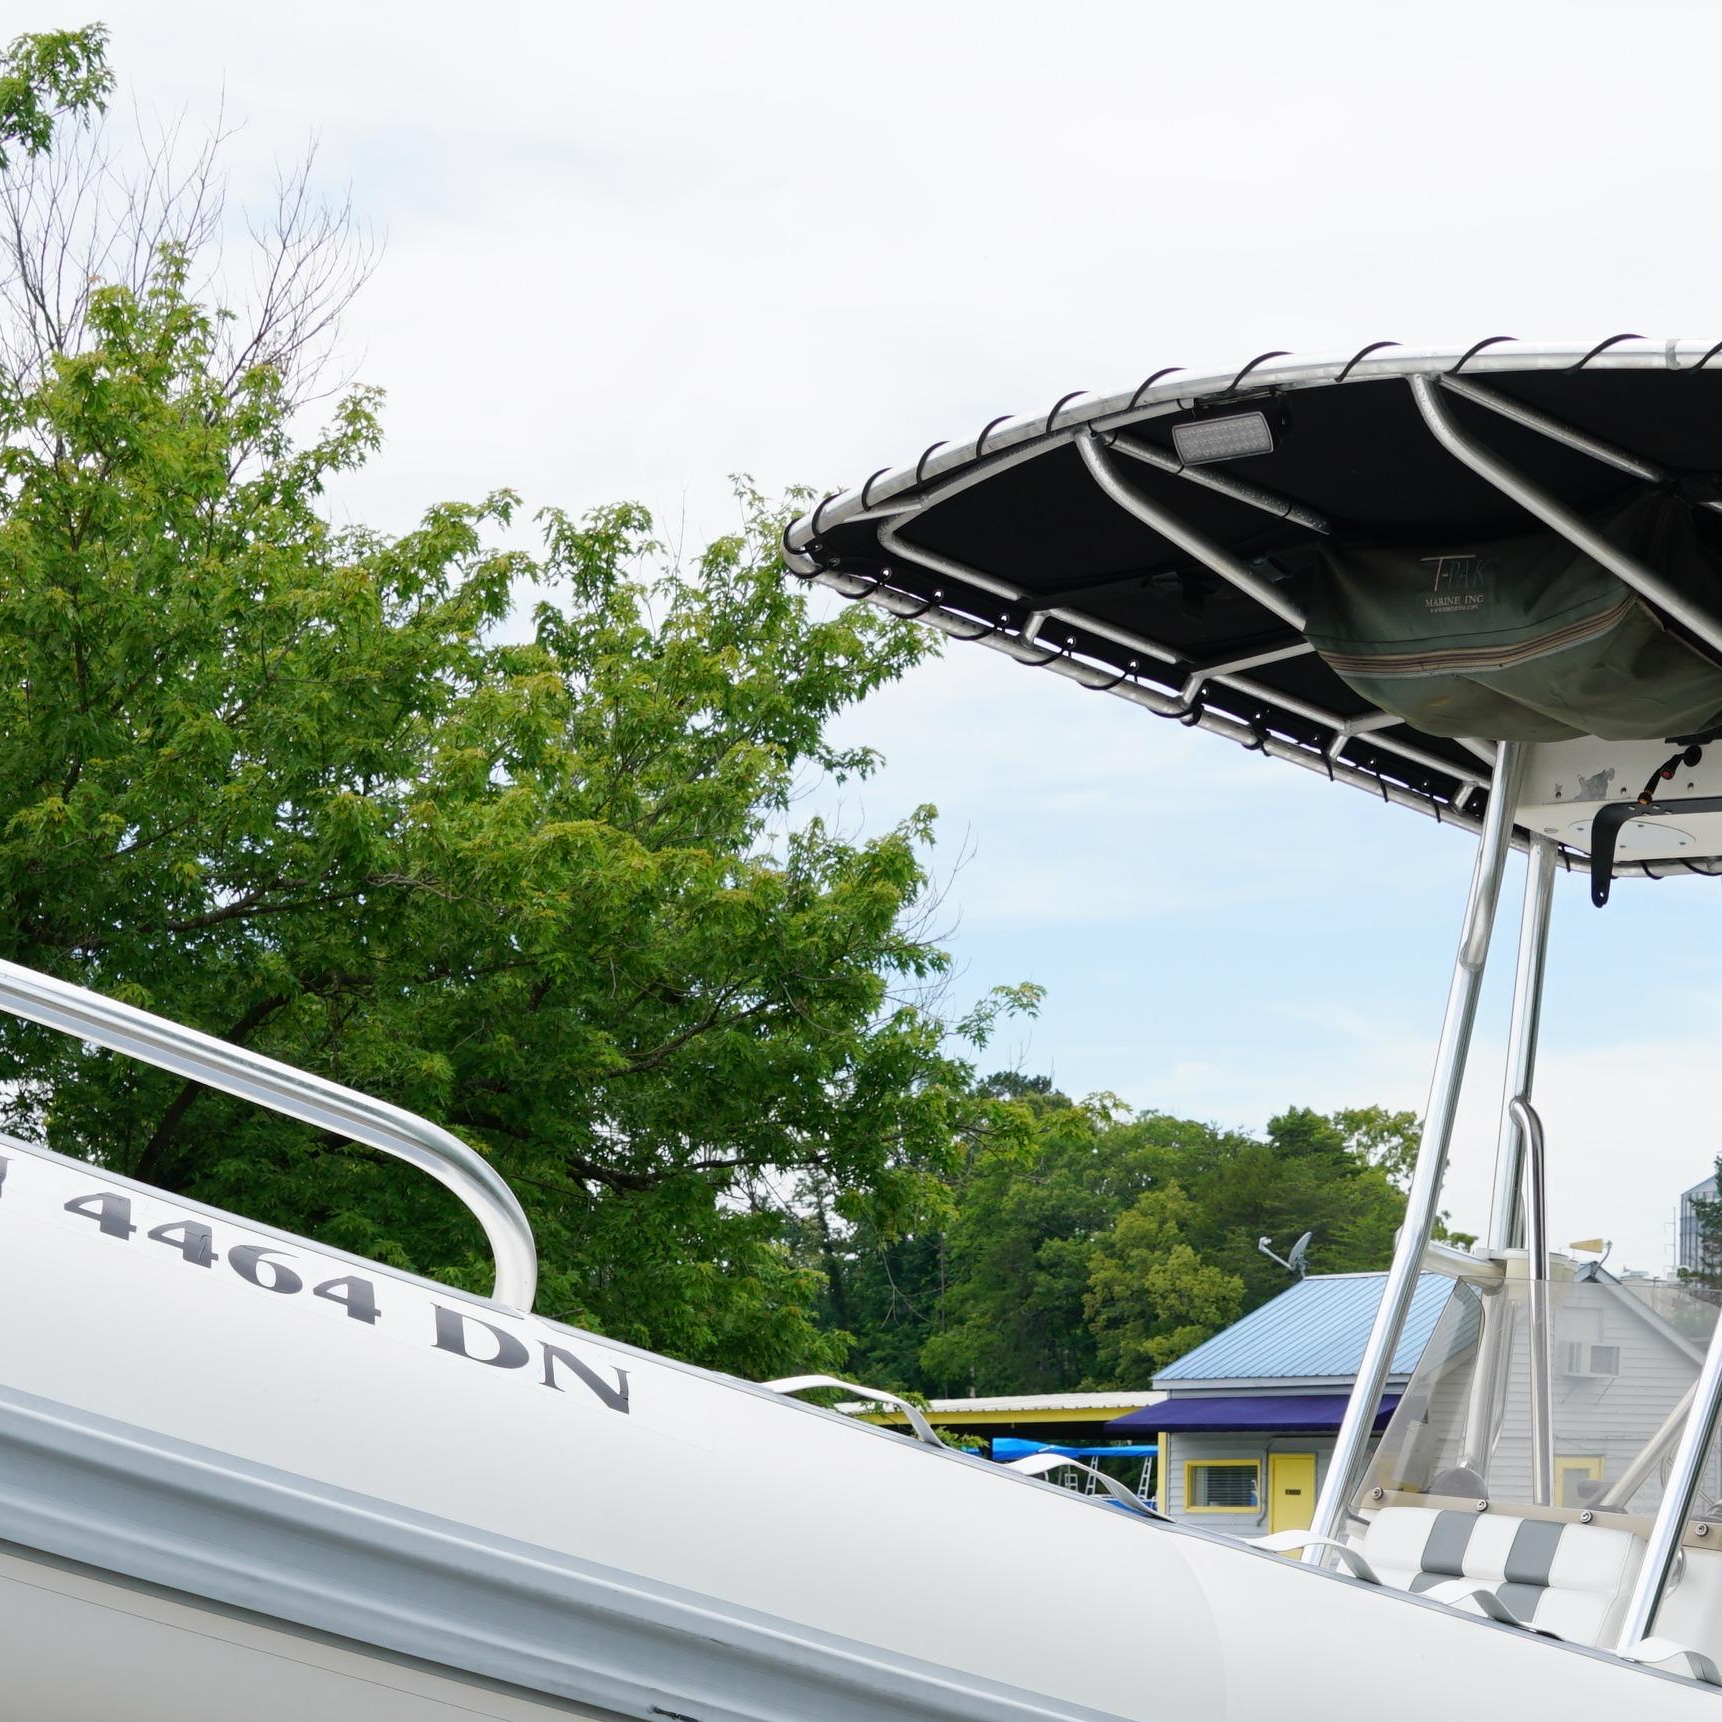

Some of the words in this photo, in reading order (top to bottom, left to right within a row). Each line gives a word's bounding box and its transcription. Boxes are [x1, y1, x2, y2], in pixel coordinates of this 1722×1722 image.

[1424, 596, 1461, 608] MARINE
[1464, 594, 1484, 605] INC
[64, 1191, 381, 1325] 4464
[432, 1303, 631, 1414] DN
